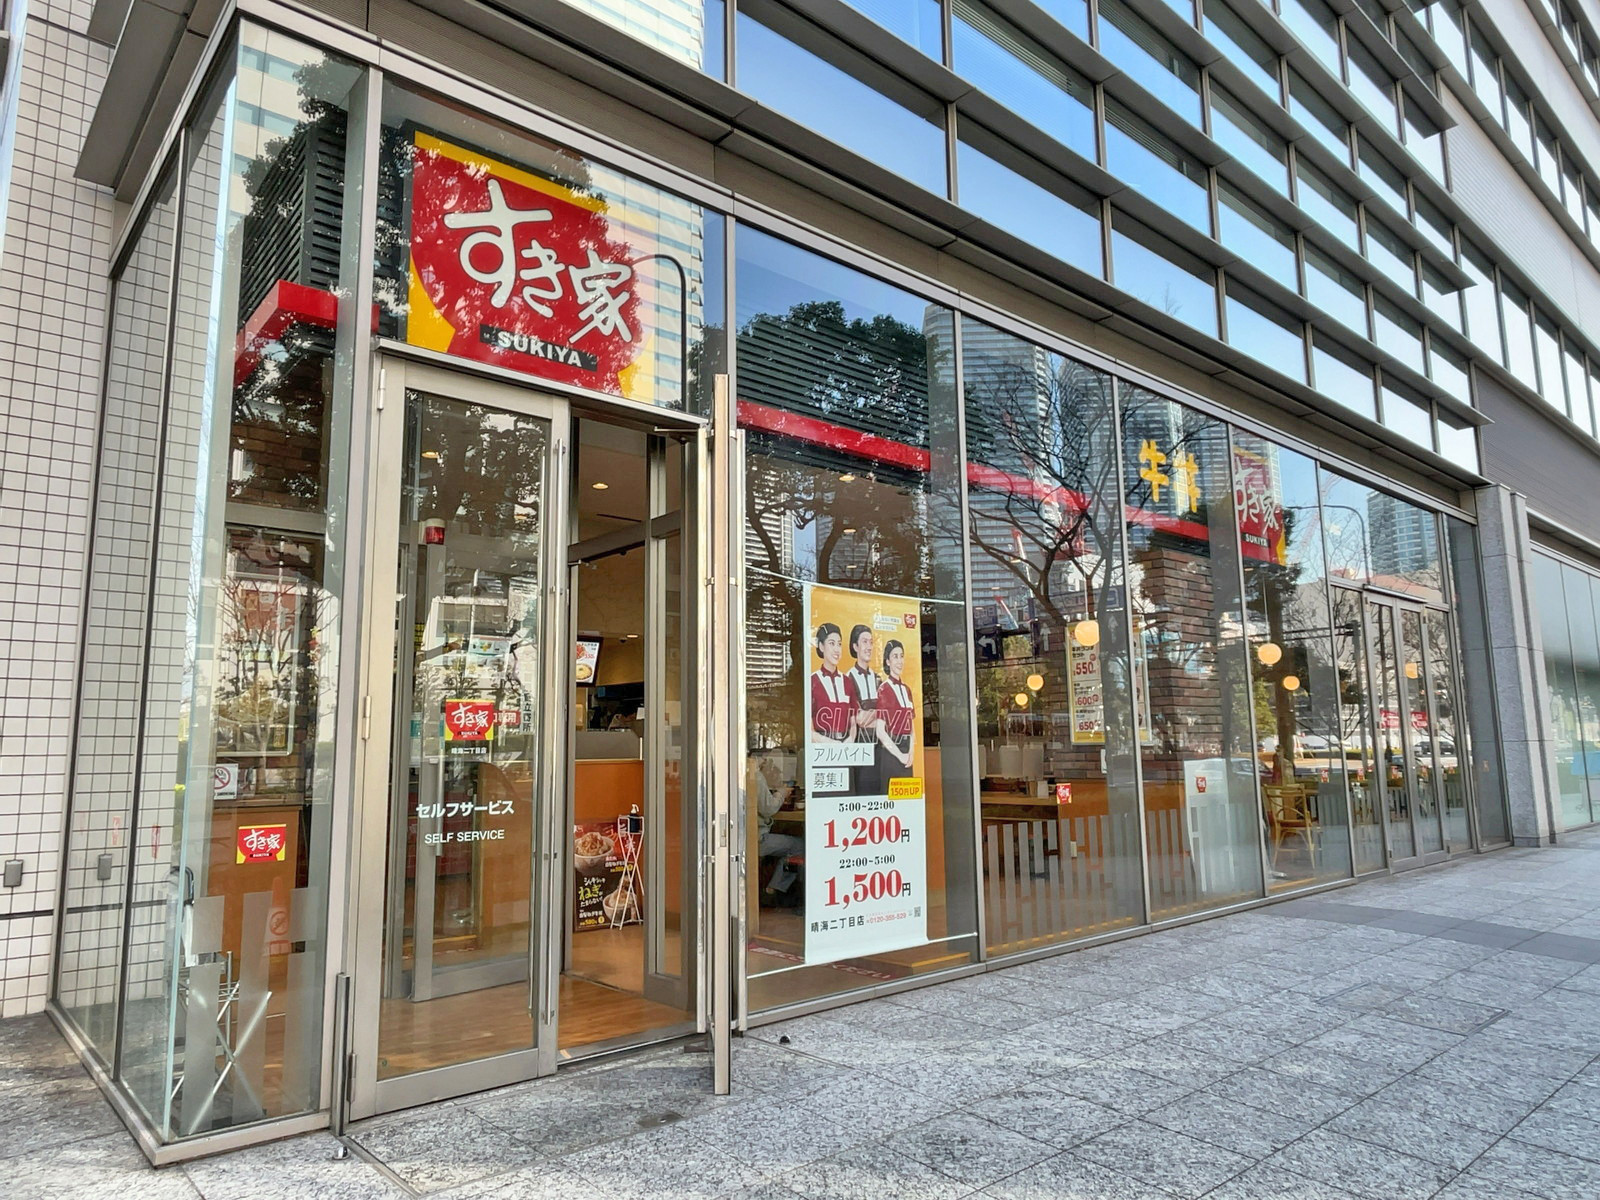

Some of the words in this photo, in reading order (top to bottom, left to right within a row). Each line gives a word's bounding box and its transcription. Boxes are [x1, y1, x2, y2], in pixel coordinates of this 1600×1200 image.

[443, 178, 632, 343] すき家
[497, 331, 582, 368] SUKIYA
[1139, 439, 1201, 513] 牛丼
[1234, 457, 1279, 535] すき家
[1245, 533, 1268, 547] SUKIYA
[1075, 662, 1094, 675] 550
[451, 702, 488, 731] すき家
[815, 706, 916, 745] SUKIYA
[813, 747, 871, 762] アルバイト
[813, 772, 844, 789] 募集!
[416, 800, 515, 818] セルフサービス
[243, 829, 281, 852] すき家
[424, 832, 454, 844] SELF
[456, 829, 505, 842] SERVICE
[823, 815, 910, 852] 1,200円
[824, 869, 911, 909] 1,500円
[811, 915, 865, 933] 晴海二丁目店
